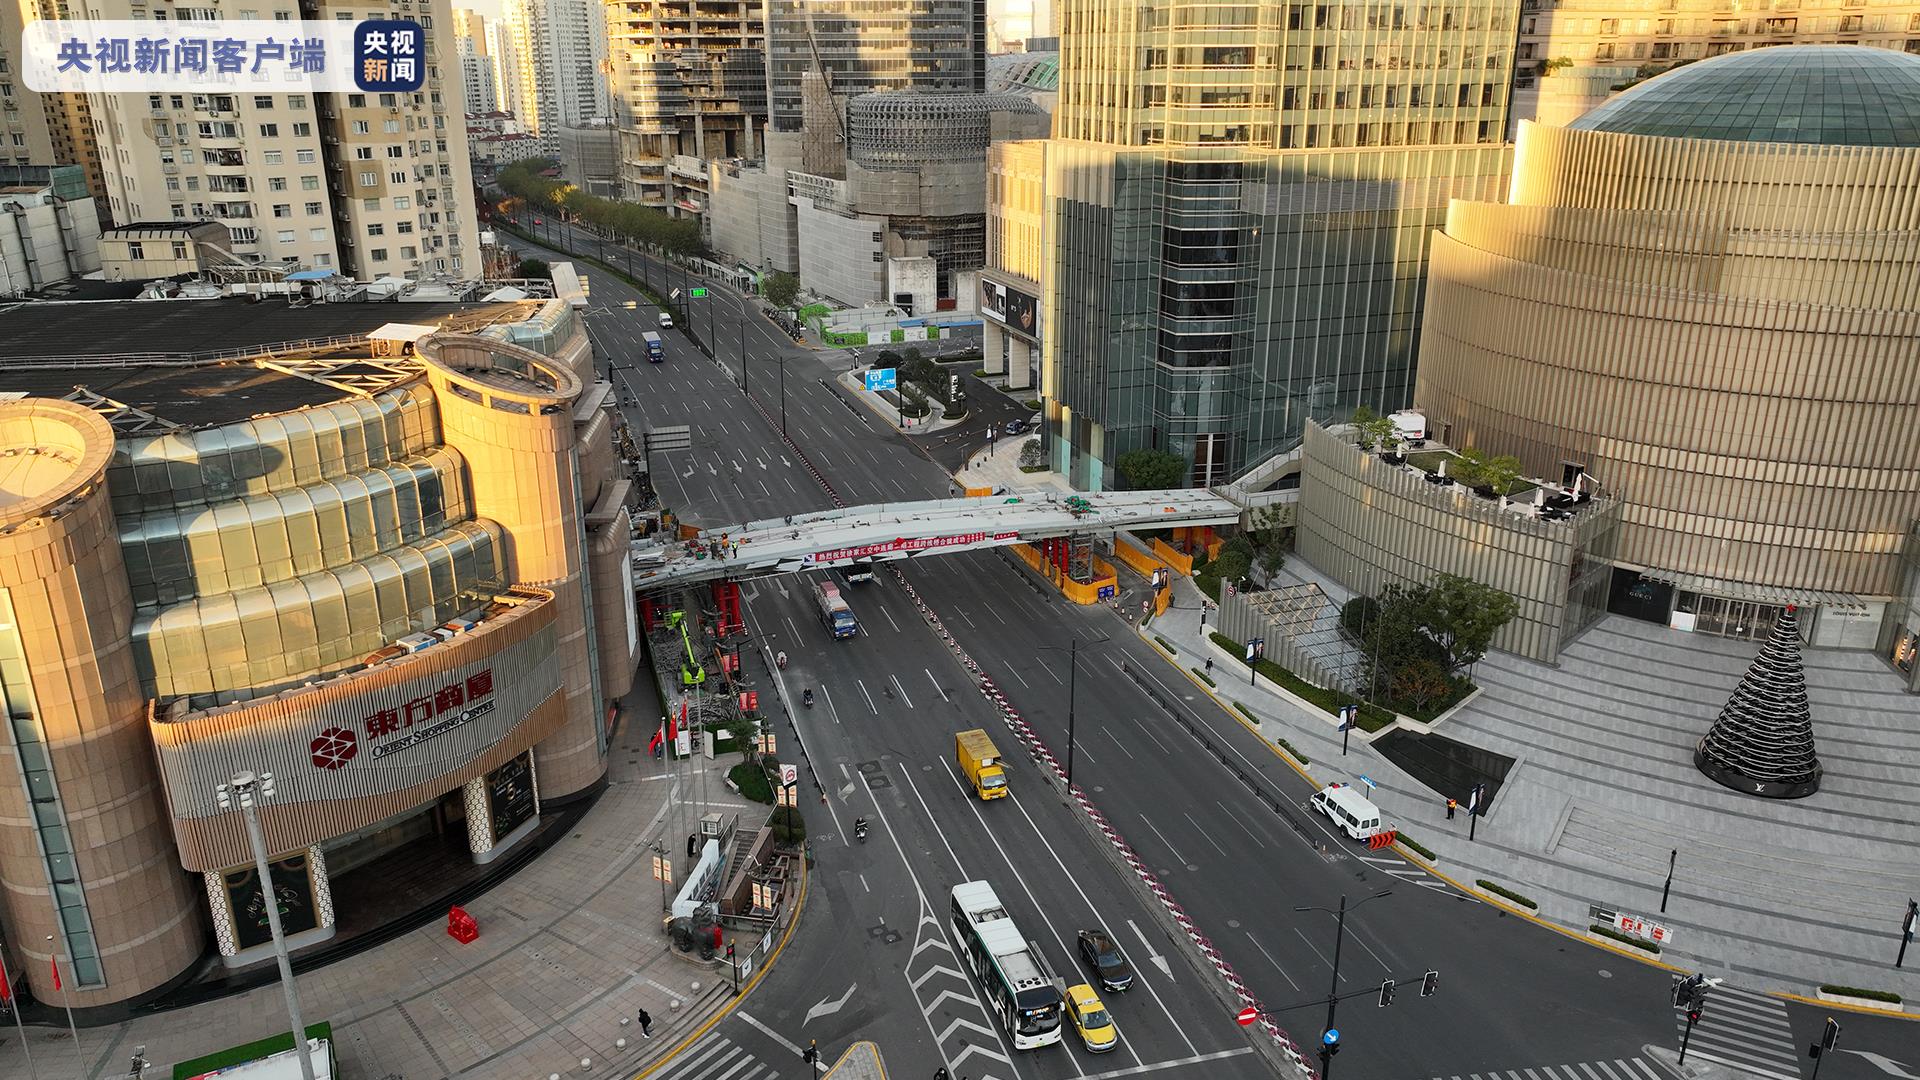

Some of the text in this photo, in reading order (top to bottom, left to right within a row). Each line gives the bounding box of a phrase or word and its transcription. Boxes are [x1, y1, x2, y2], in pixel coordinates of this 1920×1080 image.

[1629, 591, 1652, 601] GUCCI
[373, 700, 495, 757] ORIENT SHOPPING CENTRE
